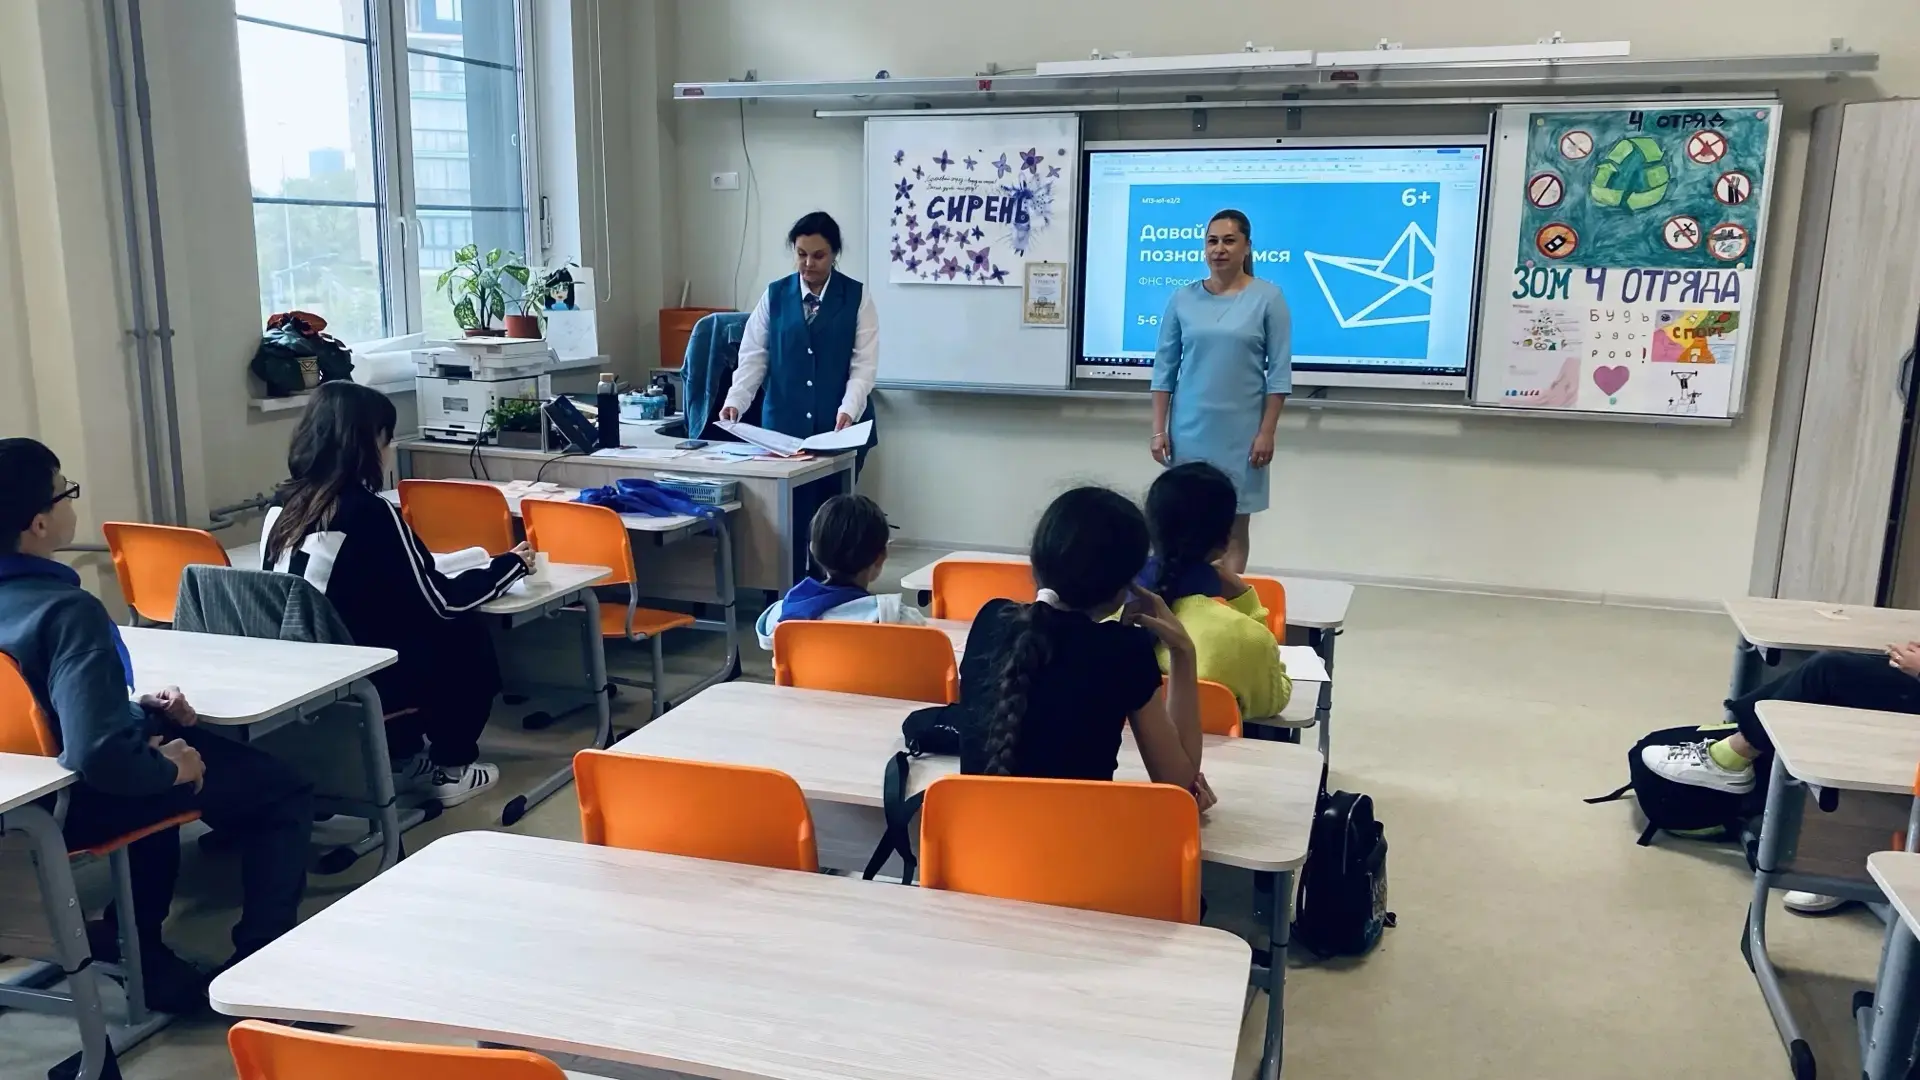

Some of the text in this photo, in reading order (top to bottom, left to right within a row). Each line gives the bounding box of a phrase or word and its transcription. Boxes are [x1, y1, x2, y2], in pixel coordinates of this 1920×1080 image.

[1401, 187, 1431, 207] 6+
[926, 195, 1030, 224] СИРЕНЬ
[1138, 276, 1163, 286] ФНС
[1621, 268, 1741, 303] ОТРЯДА
[1136, 315, 1158, 325] 5-6
[1672, 326, 1726, 341] СПОРТ
